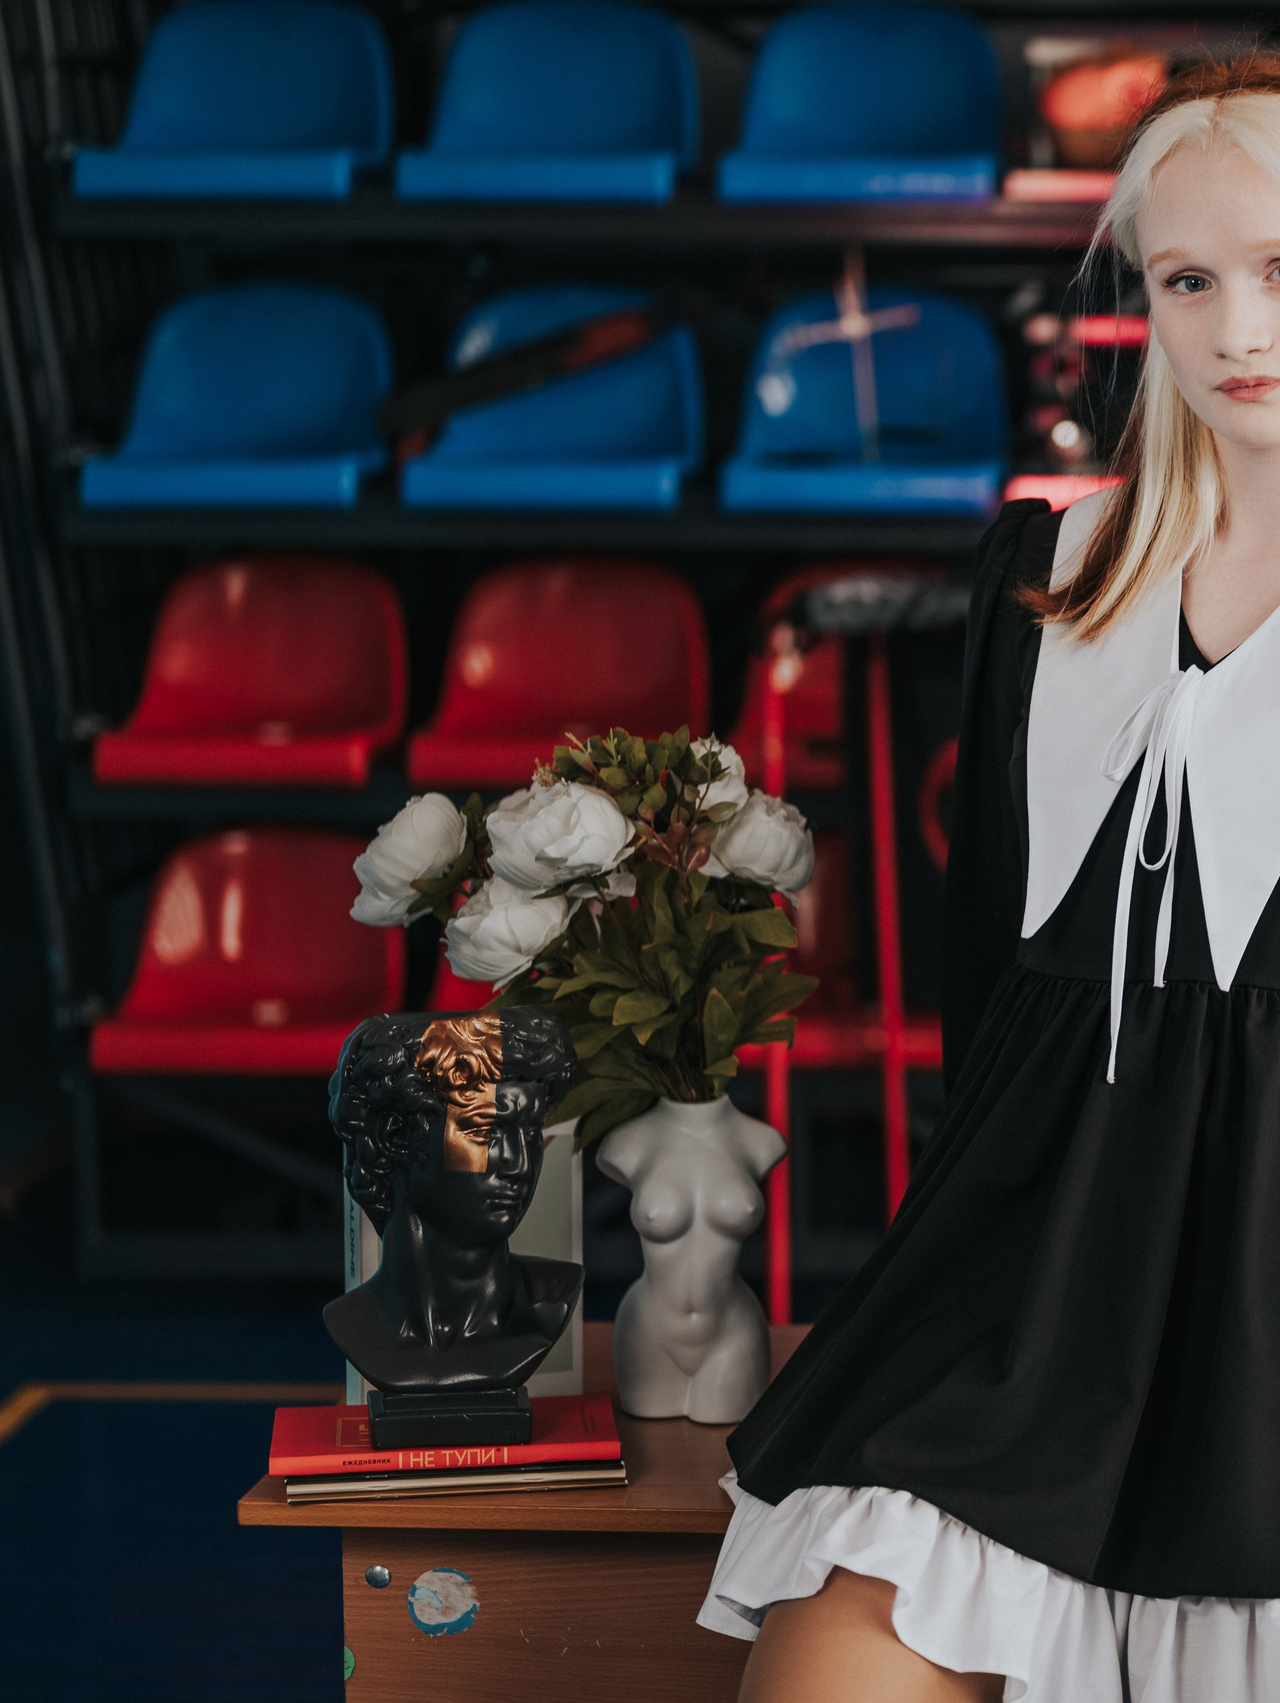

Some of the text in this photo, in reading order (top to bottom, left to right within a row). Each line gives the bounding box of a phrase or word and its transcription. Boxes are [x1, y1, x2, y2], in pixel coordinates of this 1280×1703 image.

[342, 1448, 495, 1468] ЕЖЕДНЕВНИК НЕ ТУПИ
